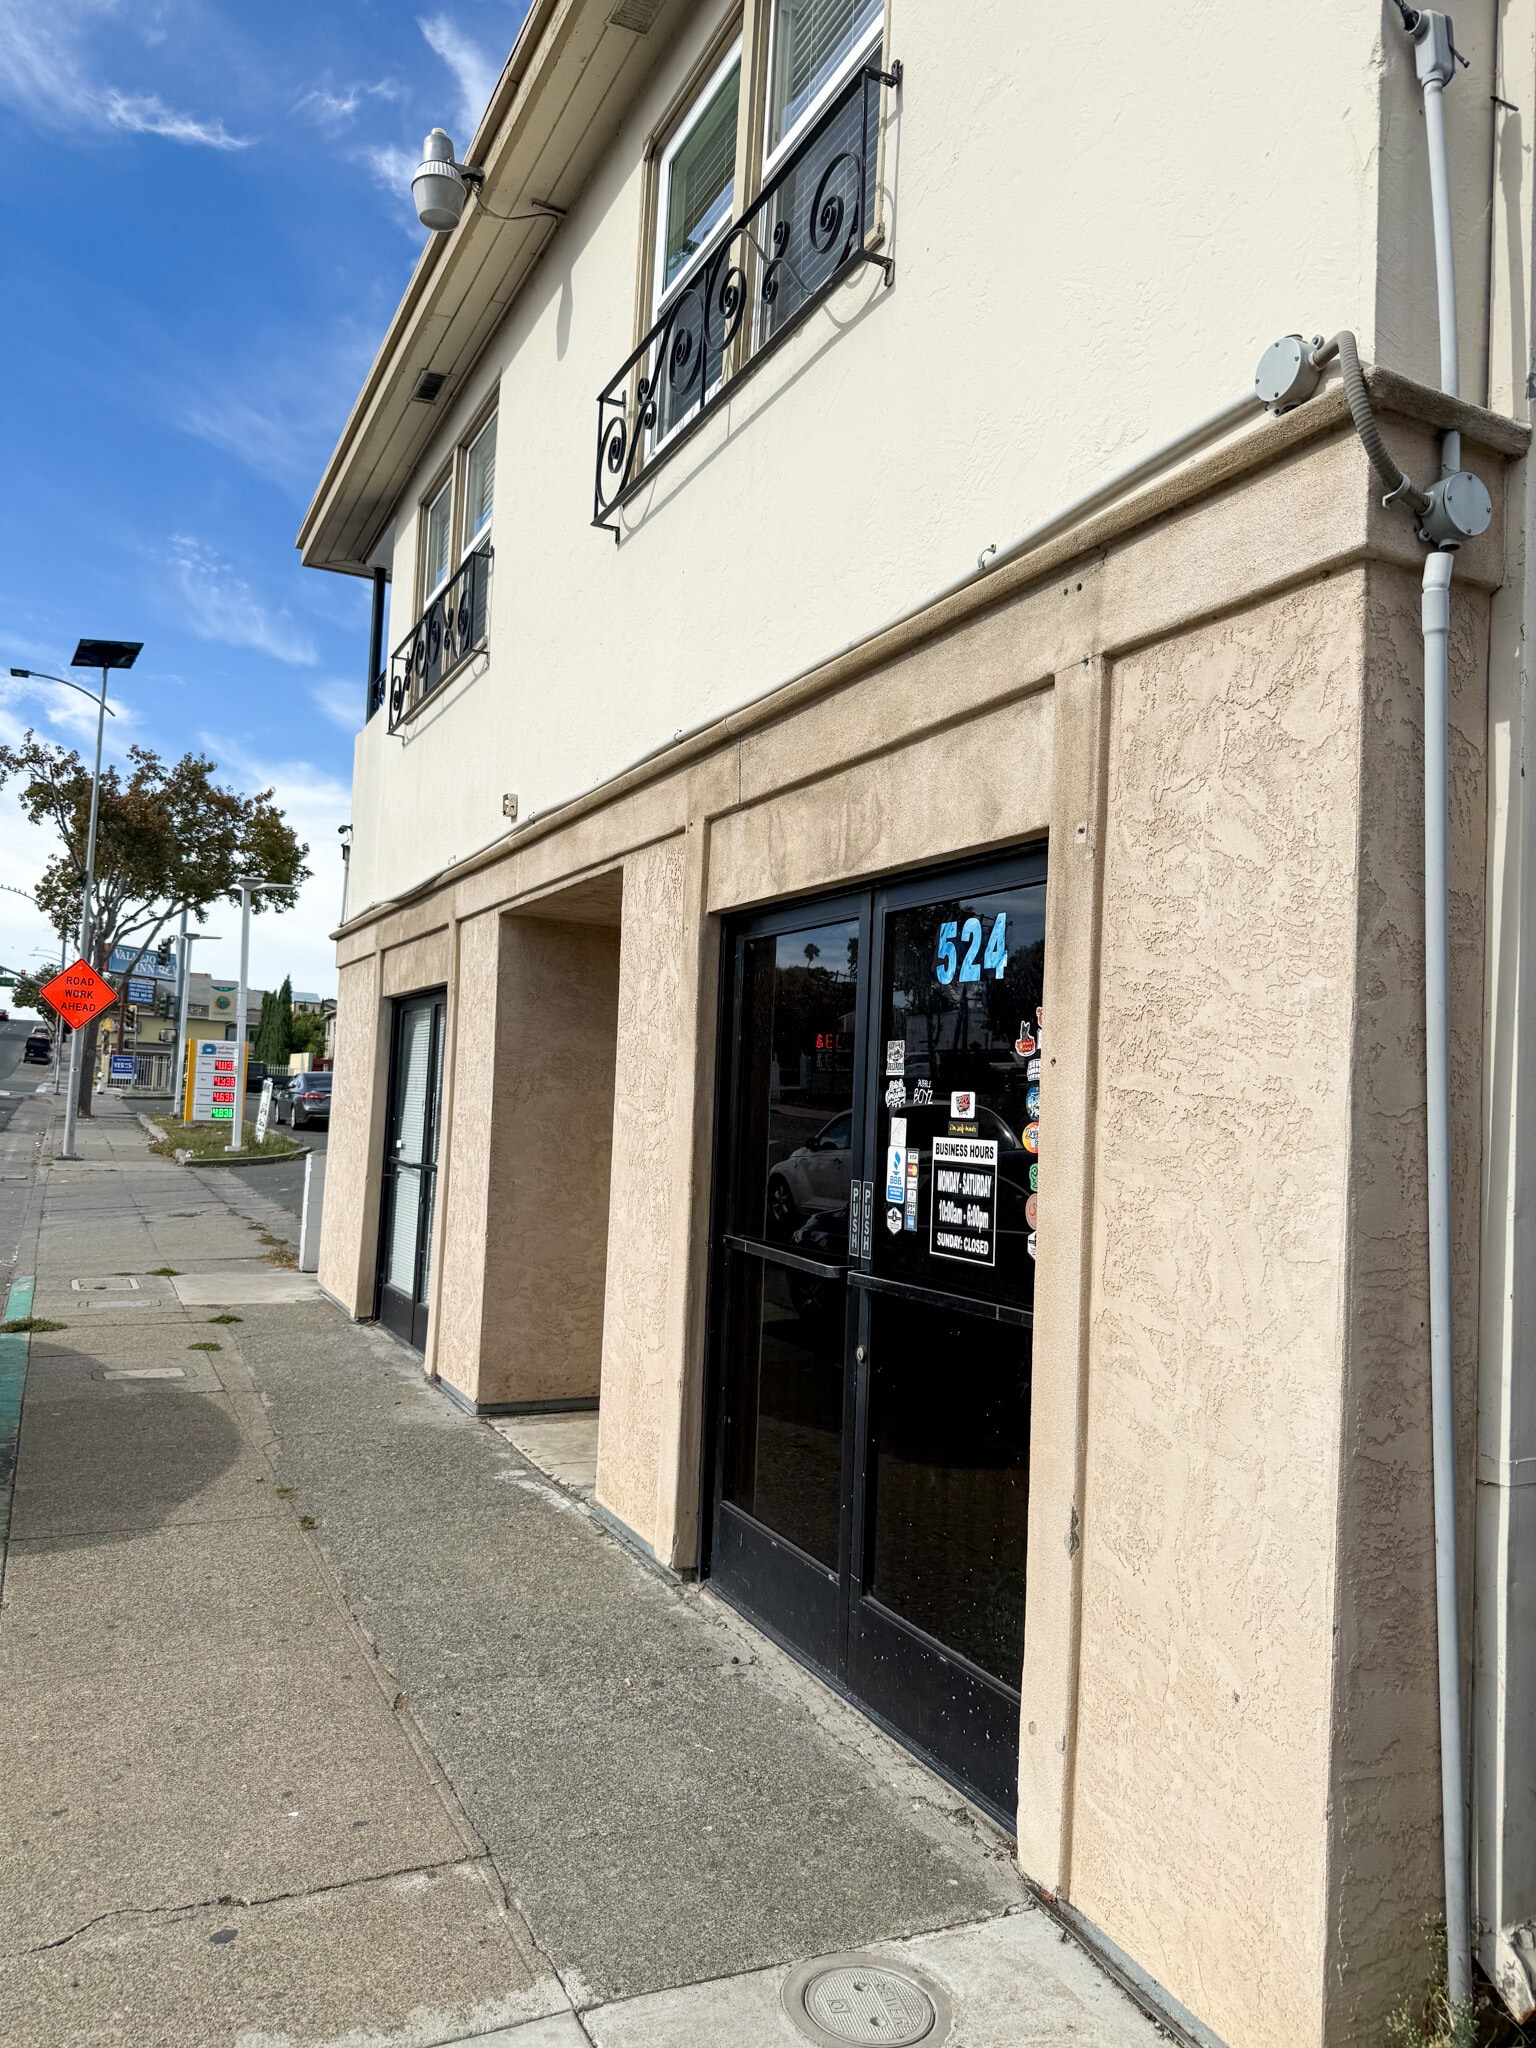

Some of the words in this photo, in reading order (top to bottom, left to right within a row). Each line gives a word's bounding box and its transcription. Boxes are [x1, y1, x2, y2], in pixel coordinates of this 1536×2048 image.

[936, 912, 1008, 985] 524
[136, 962, 155, 974] INN
[66, 976, 95, 986] ROAD
[65, 989, 94, 999] WORK
[61, 1002, 96, 1012] AHEAD
[913, 1087, 933, 1105] BOYZ
[935, 1143, 968, 1158] BUSINESS
[969, 1145, 994, 1159] HOURS
[937, 1170, 960, 1193] MONDAY
[962, 1172, 992, 1198] SATURDAY
[851, 1188, 859, 1248] PUSH
[863, 1189, 871, 1251] PUSH
[939, 1199, 962, 1224] 10:00am
[966, 1204, 989, 1233] 6:00pm
[937, 1232, 963, 1250] SUNDAY:
[963, 1237, 989, 1254] CLOSED
